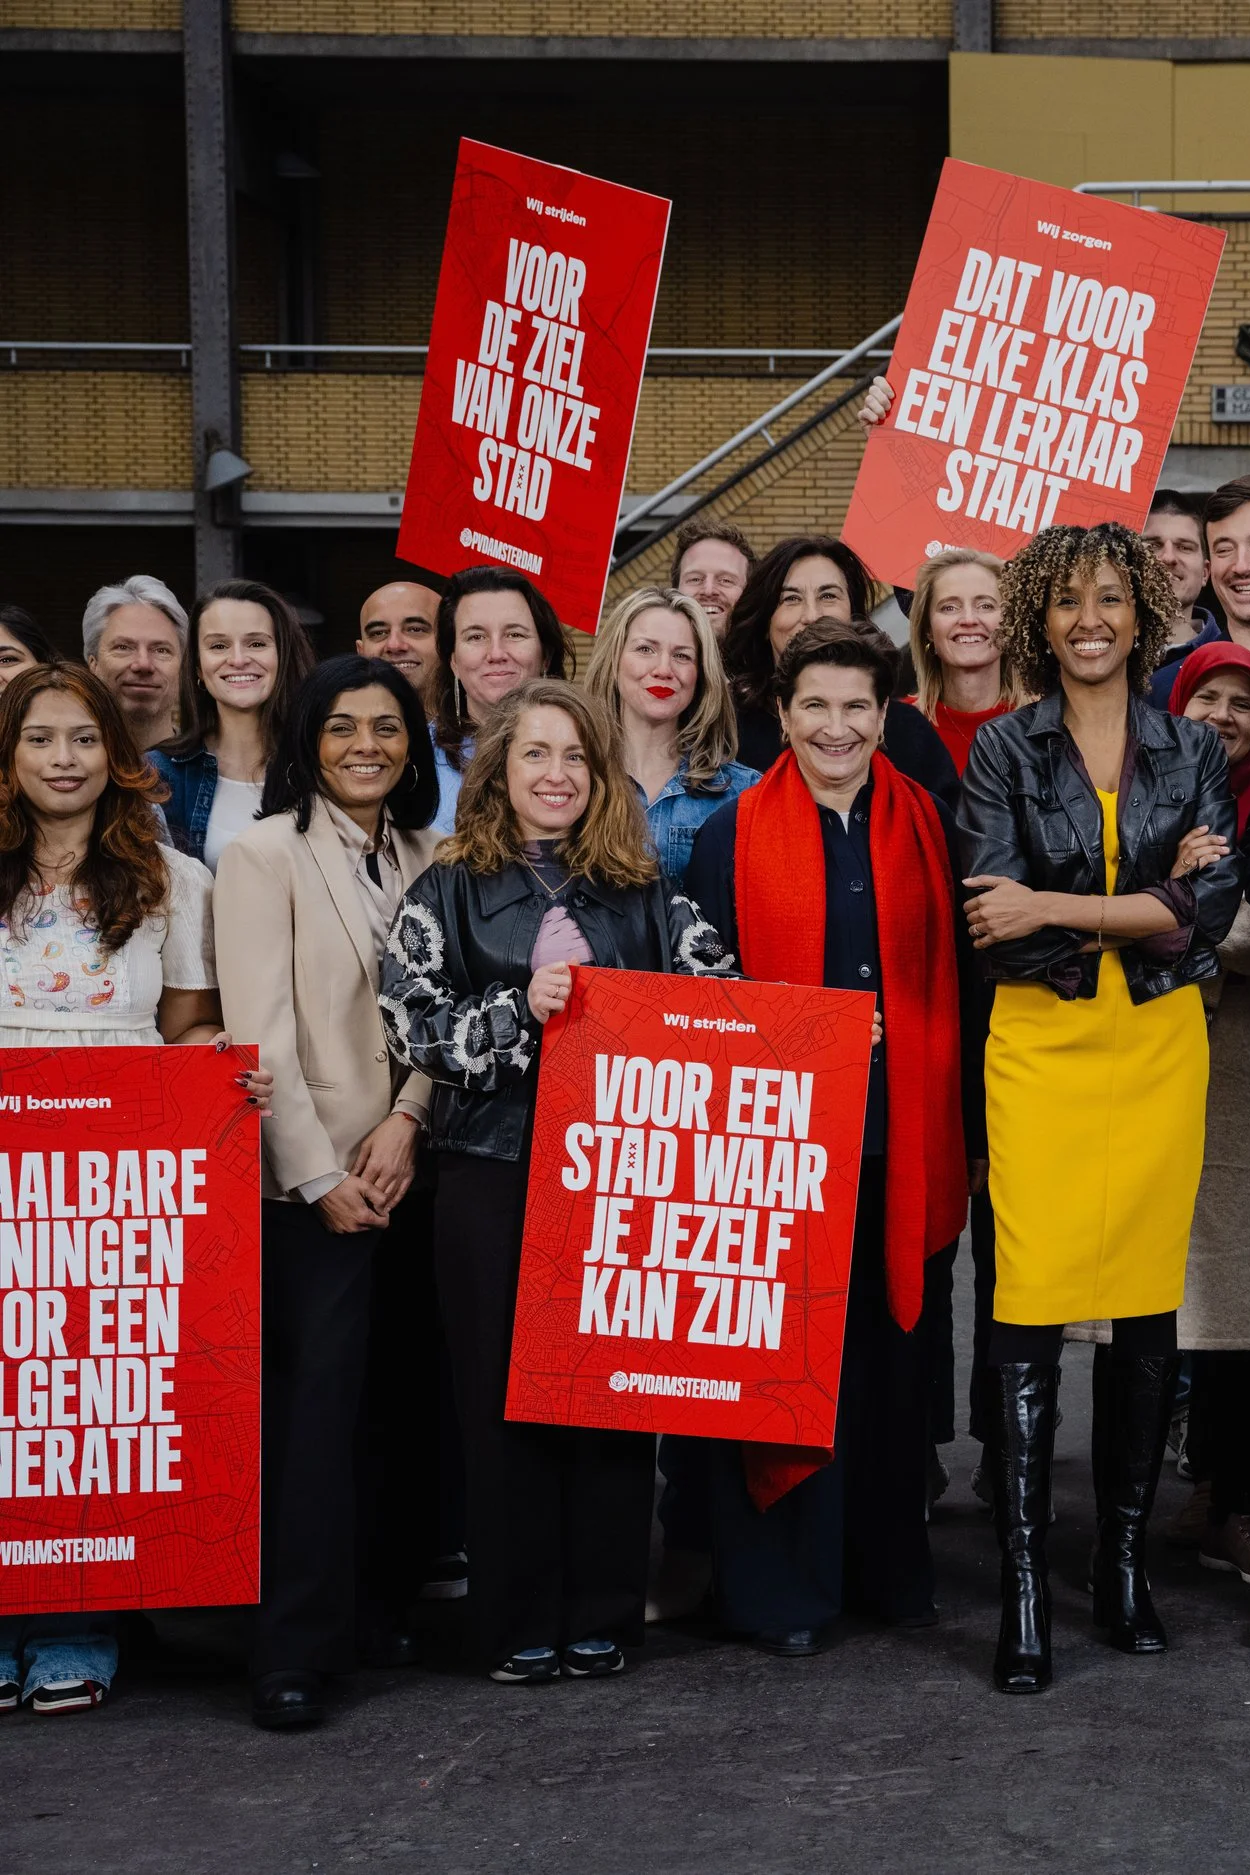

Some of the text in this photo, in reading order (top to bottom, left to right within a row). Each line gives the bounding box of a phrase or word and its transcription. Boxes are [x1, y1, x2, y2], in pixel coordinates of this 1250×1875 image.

[527, 197, 586, 226] Wij strijden
[1038, 220, 1112, 251] Wij zorgen
[505, 238, 586, 326] VOOR
[954, 248, 1155, 359] DAT VOOR
[478, 300, 585, 398] DE ZIEL
[927, 309, 1148, 423] ELKE KLAS
[452, 359, 600, 471] VAN ONZE
[894, 368, 1143, 493] EEN LERAAR
[473, 439, 552, 521] STAD
[936, 449, 1070, 536] STAAT
[664, 1013, 756, 1033] Wij strijden
[27, 1095, 111, 1109] bouwen
[596, 1054, 813, 1139] VOOR EEN
[562, 1122, 827, 1212] STAD WAAR
[583, 1196, 794, 1278] JE JEZELF
[90, 1287, 179, 1355] EEN
[578, 1266, 785, 1350] KAN ZIJN
[0, 1536, 134, 1565] VDAMSTERDAM
